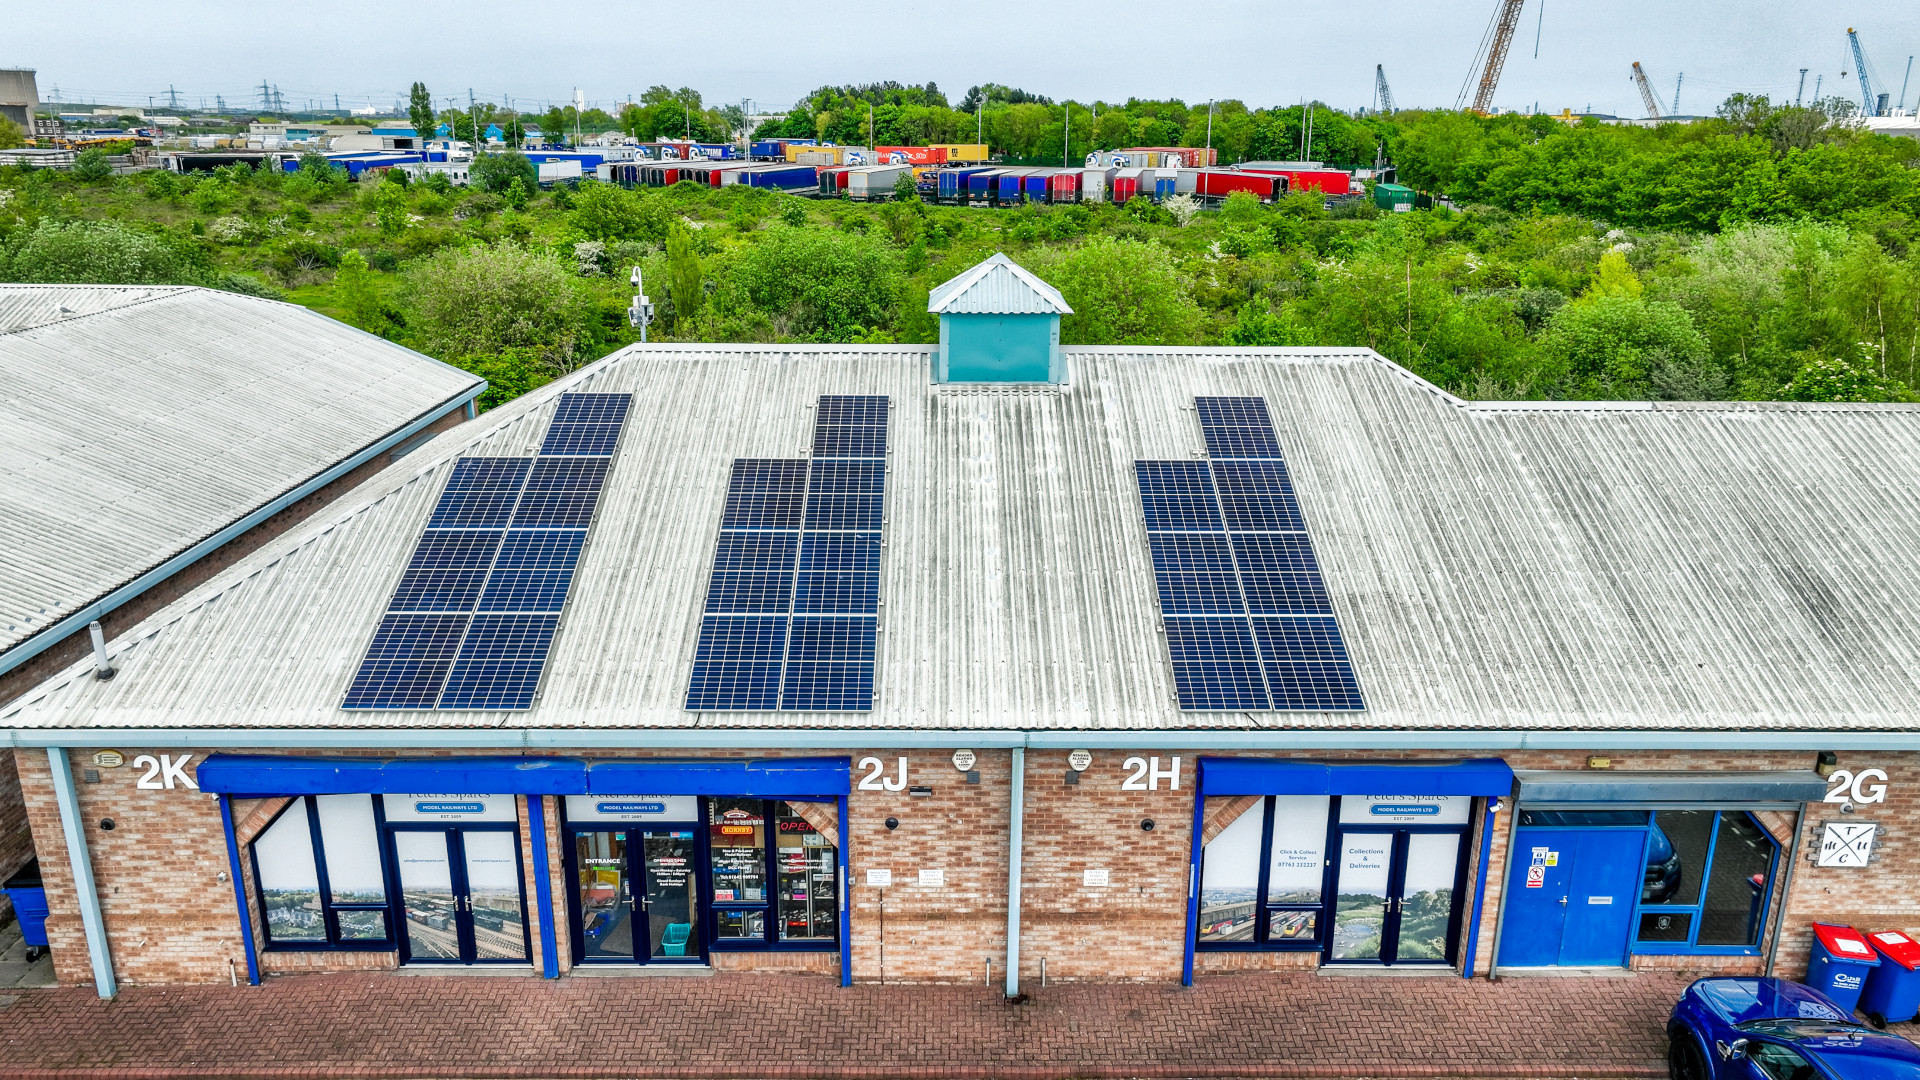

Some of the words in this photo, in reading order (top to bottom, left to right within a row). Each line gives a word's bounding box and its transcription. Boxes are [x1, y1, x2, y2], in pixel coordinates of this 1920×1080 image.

[134, 754, 200, 790] 2K
[858, 756, 908, 792] 2J
[1122, 756, 1180, 790] 2H
[1823, 769, 1888, 804] 2G
[780, 822, 814, 830] OPEN
